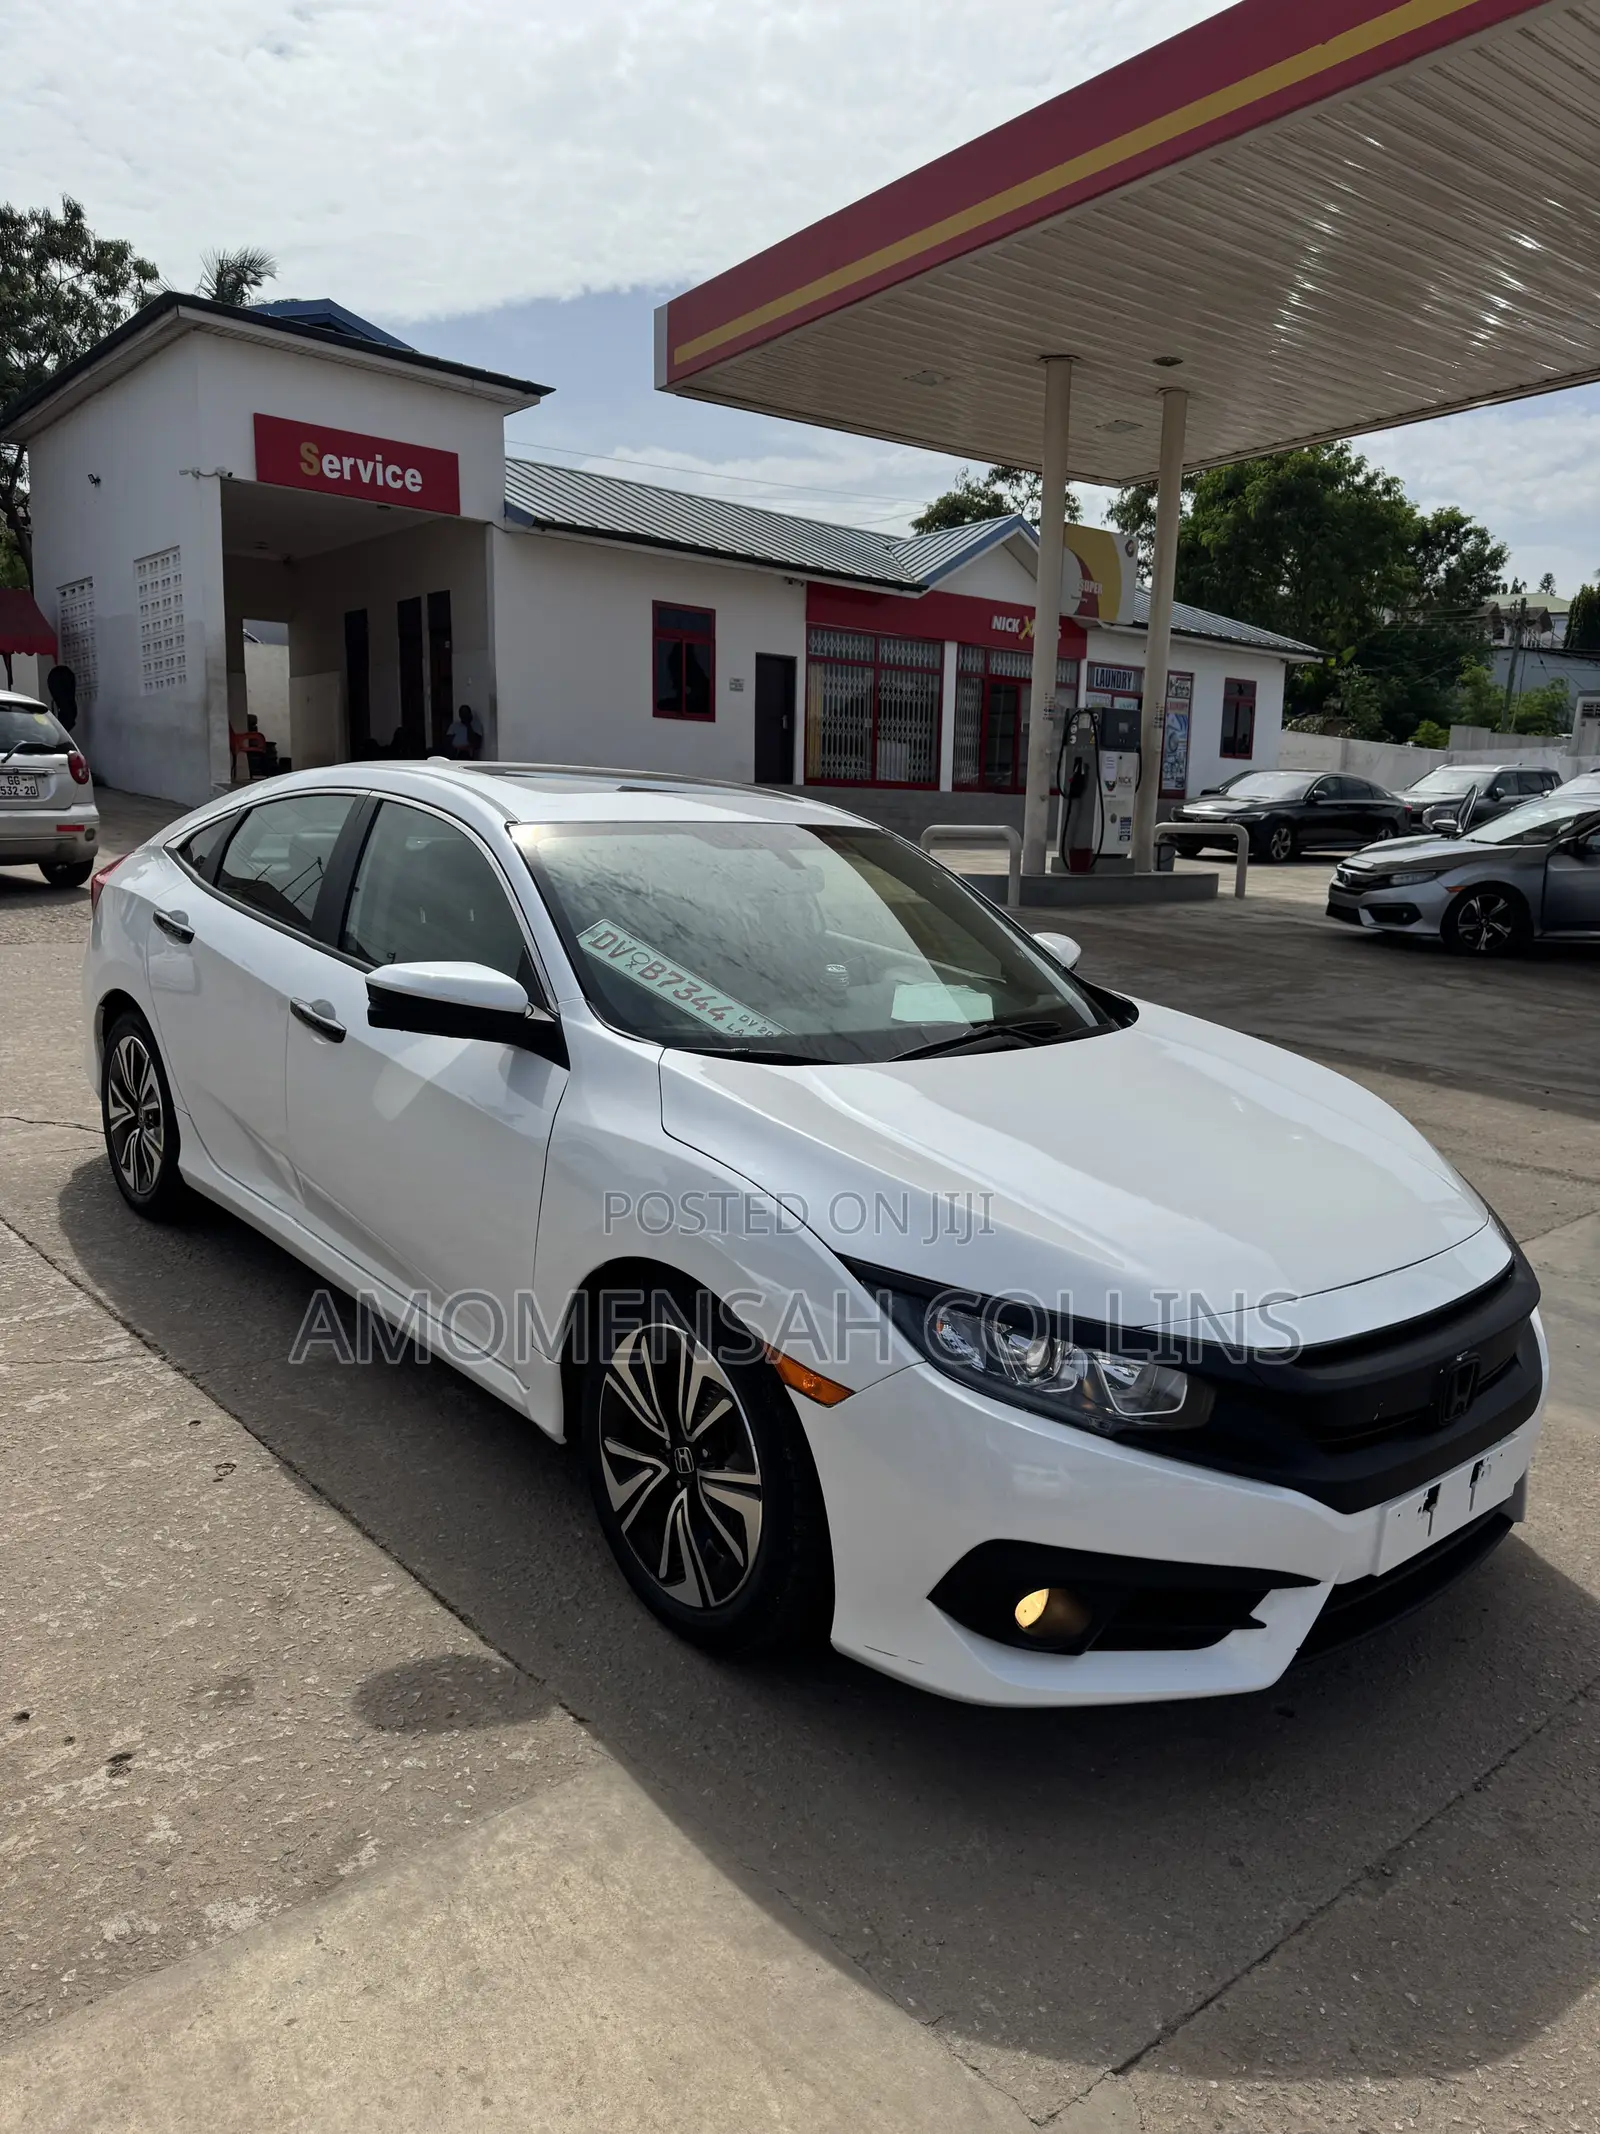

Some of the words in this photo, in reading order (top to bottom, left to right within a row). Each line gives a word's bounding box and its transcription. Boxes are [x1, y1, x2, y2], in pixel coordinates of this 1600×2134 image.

[299, 441, 423, 493] Service
[991, 615, 1020, 633] NICK
[1095, 668, 1133, 690] LAUNDRY
[587, 929, 637, 958] DV
